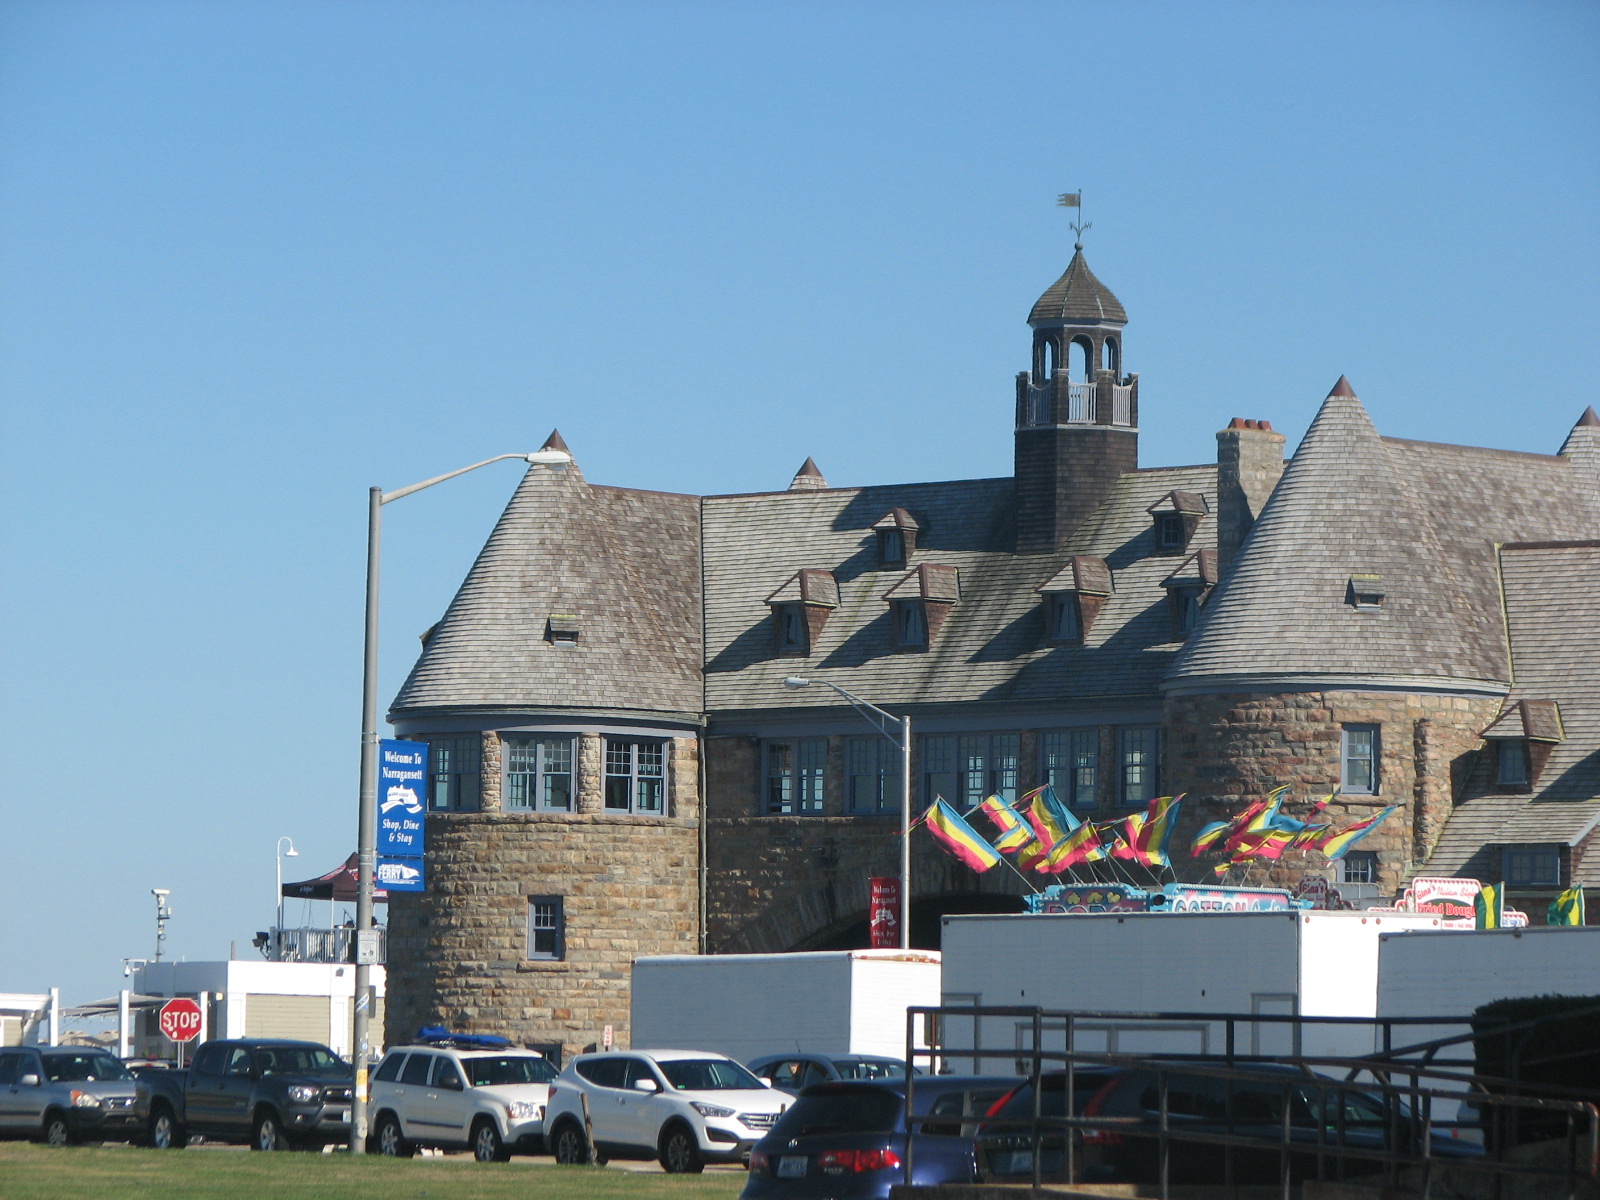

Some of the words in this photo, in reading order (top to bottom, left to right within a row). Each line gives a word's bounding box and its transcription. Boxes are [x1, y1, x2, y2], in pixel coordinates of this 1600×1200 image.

[384, 751, 412, 764] Welcome
[413, 752, 422, 764] To
[382, 766, 423, 782] Narragansett
[382, 818, 401, 832] Shop,
[403, 819, 420, 830] Dine
[388, 832, 395, 842] &
[396, 832, 413, 846] Stay
[378, 867, 401, 880] FERRY
[1416, 884, 1436, 900] Gina's
[1417, 903, 1444, 914] Fried
[163, 1011, 200, 1028] STOP
